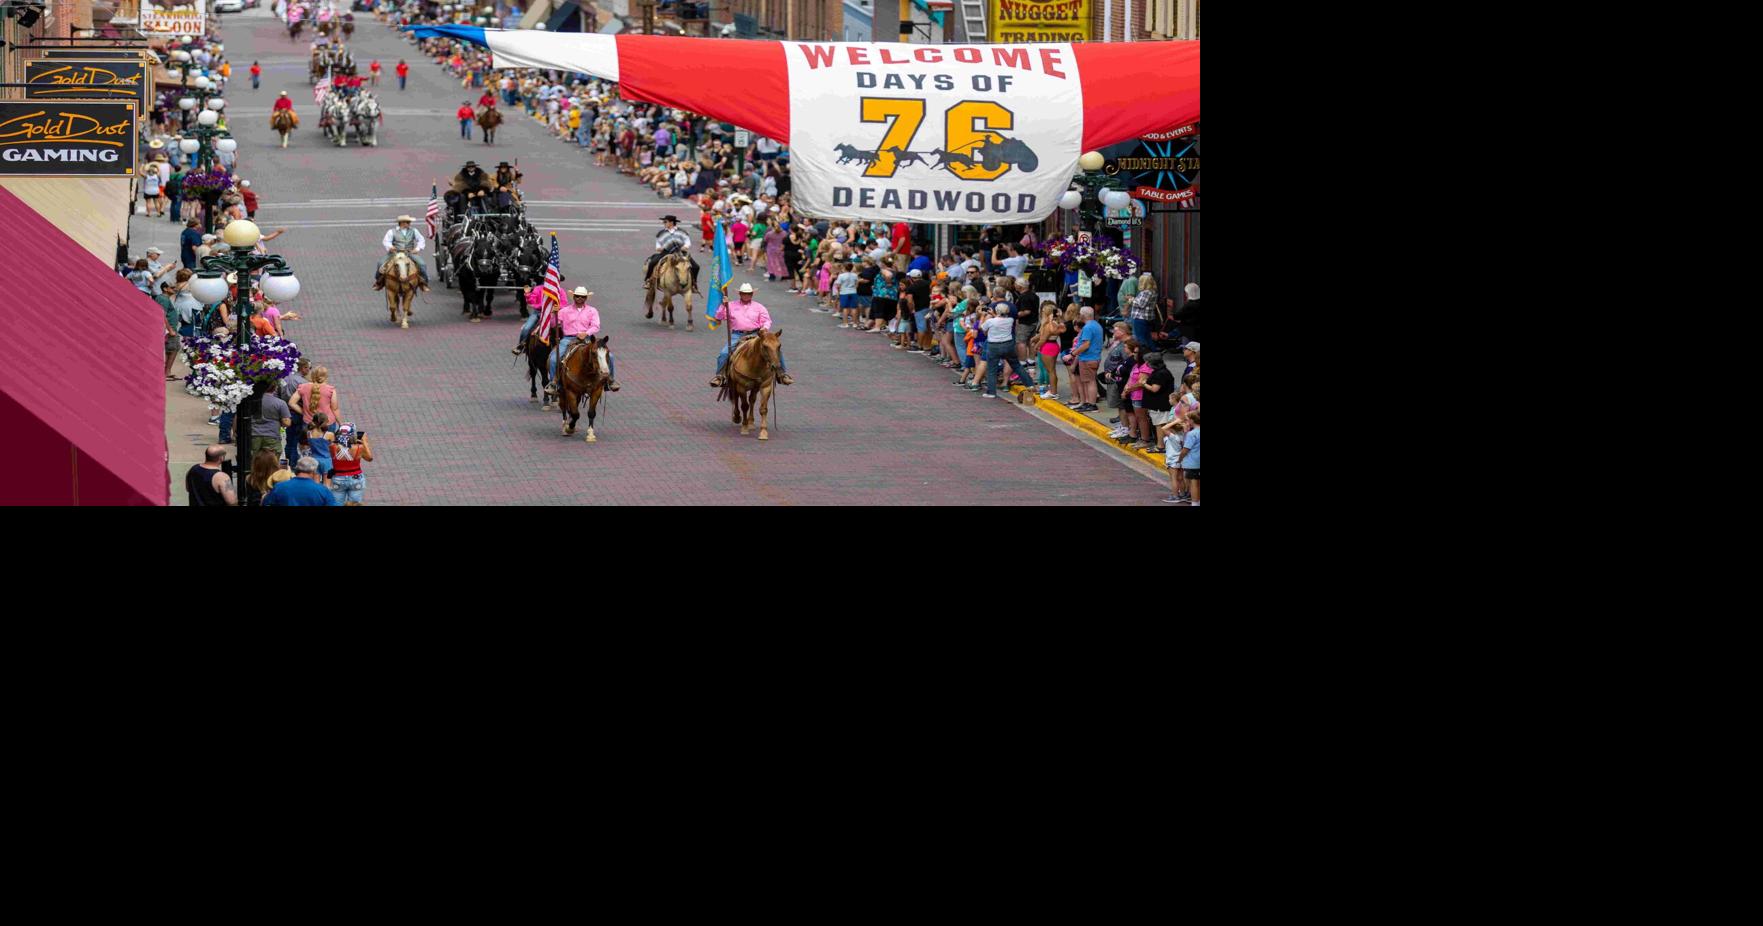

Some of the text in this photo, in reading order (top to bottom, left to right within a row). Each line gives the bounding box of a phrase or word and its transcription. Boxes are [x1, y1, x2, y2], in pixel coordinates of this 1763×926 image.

[999, 0, 1082, 21] NUGGET
[143, 20, 202, 33] SALOON
[1000, 32, 1083, 43] TRADING
[798, 44, 1066, 80] WELCOME
[30, 65, 142, 89] Gold Dust
[856, 72, 1014, 93] DAYS OF
[0, 110, 131, 139] Gold Dust
[1166, 125, 1193, 138] EVENTS
[860, 97, 1014, 182] 76
[2, 148, 119, 163] GAMING
[1105, 157, 1176, 176] MIDNIGHT
[833, 186, 1037, 214] DEADWOOD
[1140, 188, 1193, 200] TABLE GAMES
[1107, 217, 1131, 226] Diamond
